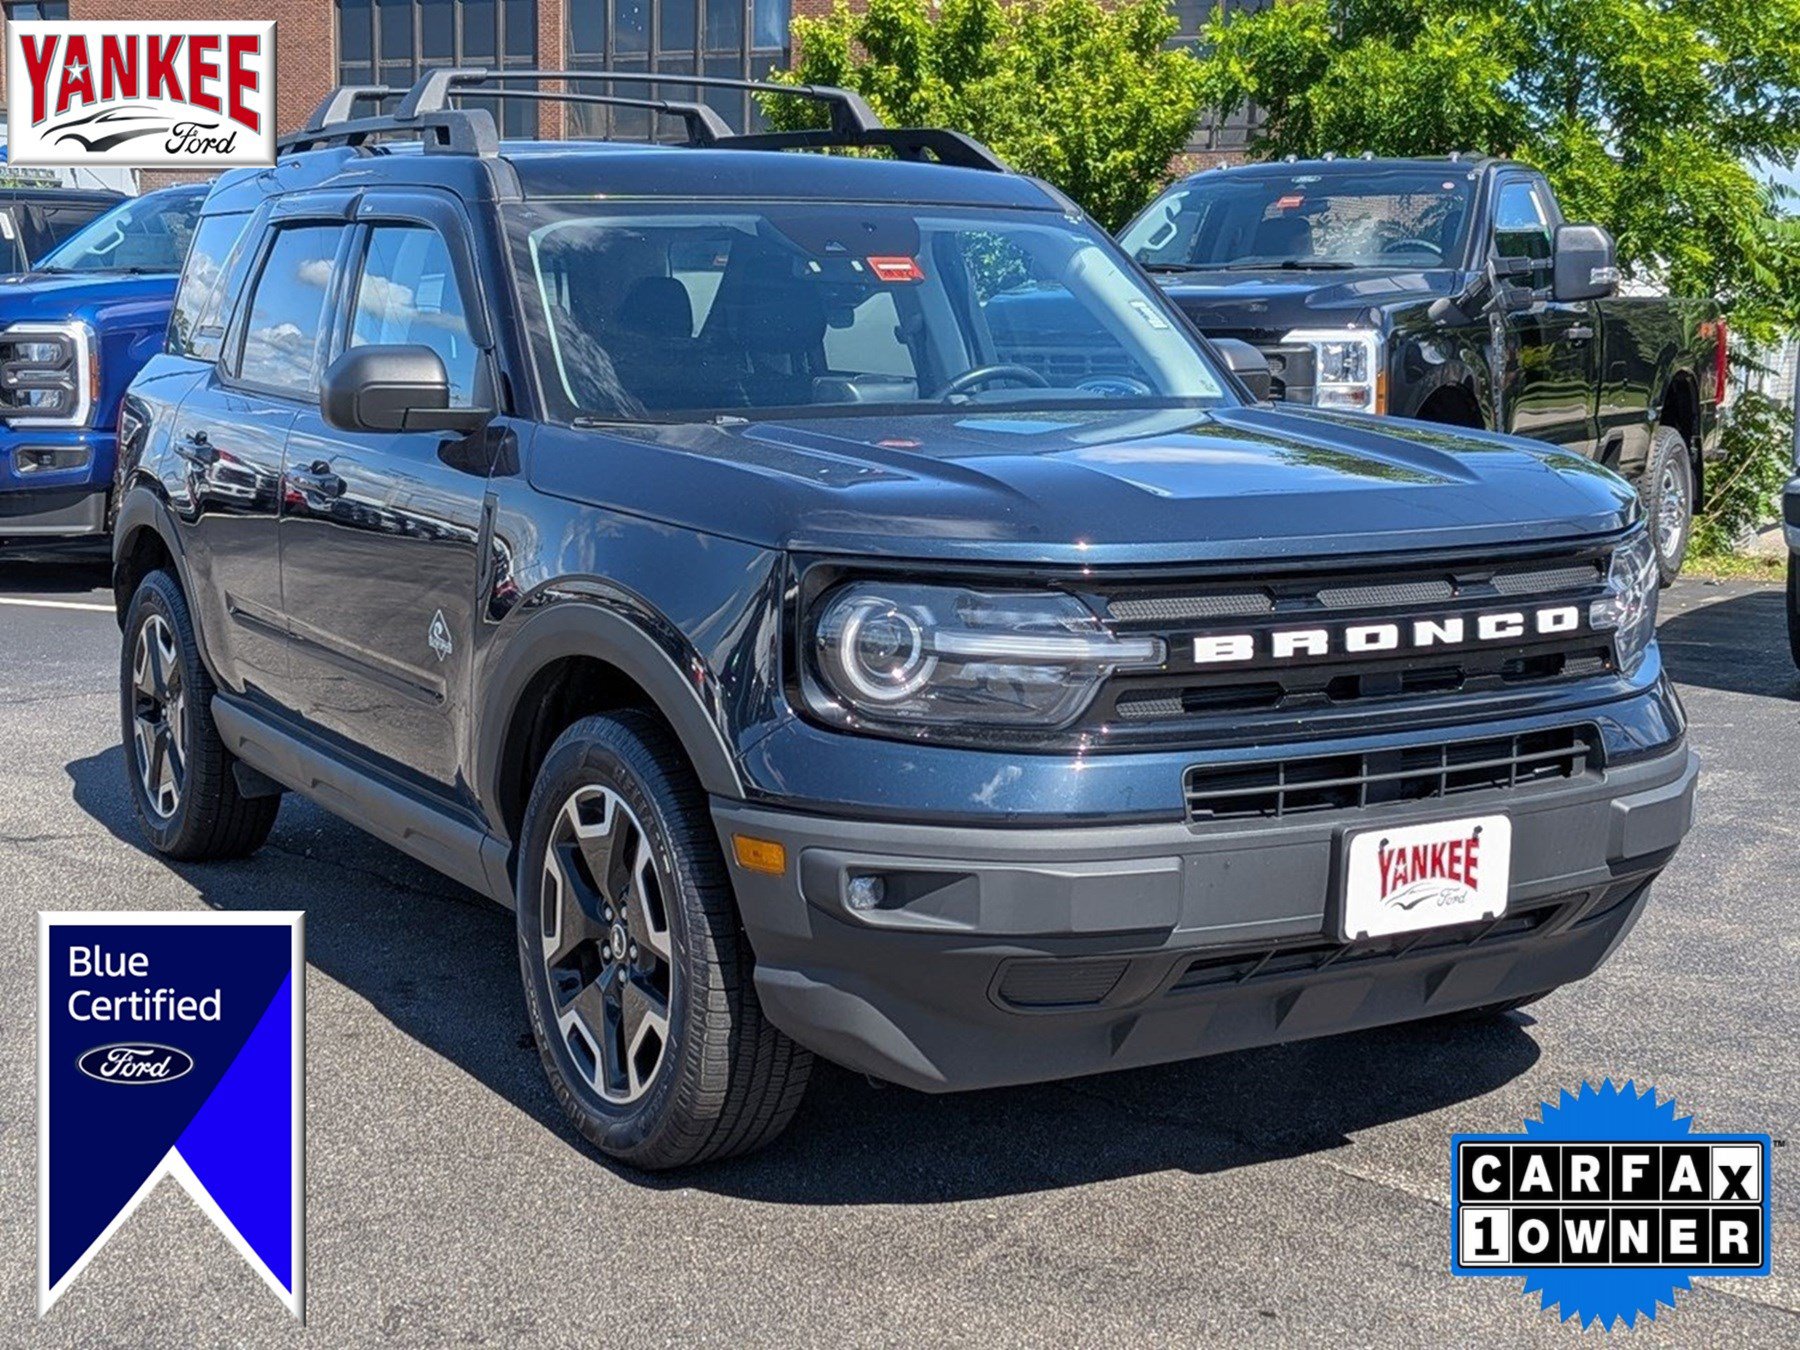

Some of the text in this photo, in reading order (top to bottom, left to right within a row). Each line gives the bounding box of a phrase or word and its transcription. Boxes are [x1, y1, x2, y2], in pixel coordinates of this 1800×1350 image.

[1193, 605, 1580, 664] BRONCO
[1378, 837, 1480, 901] YANKEE
[1436, 887, 1467, 907] Ford
